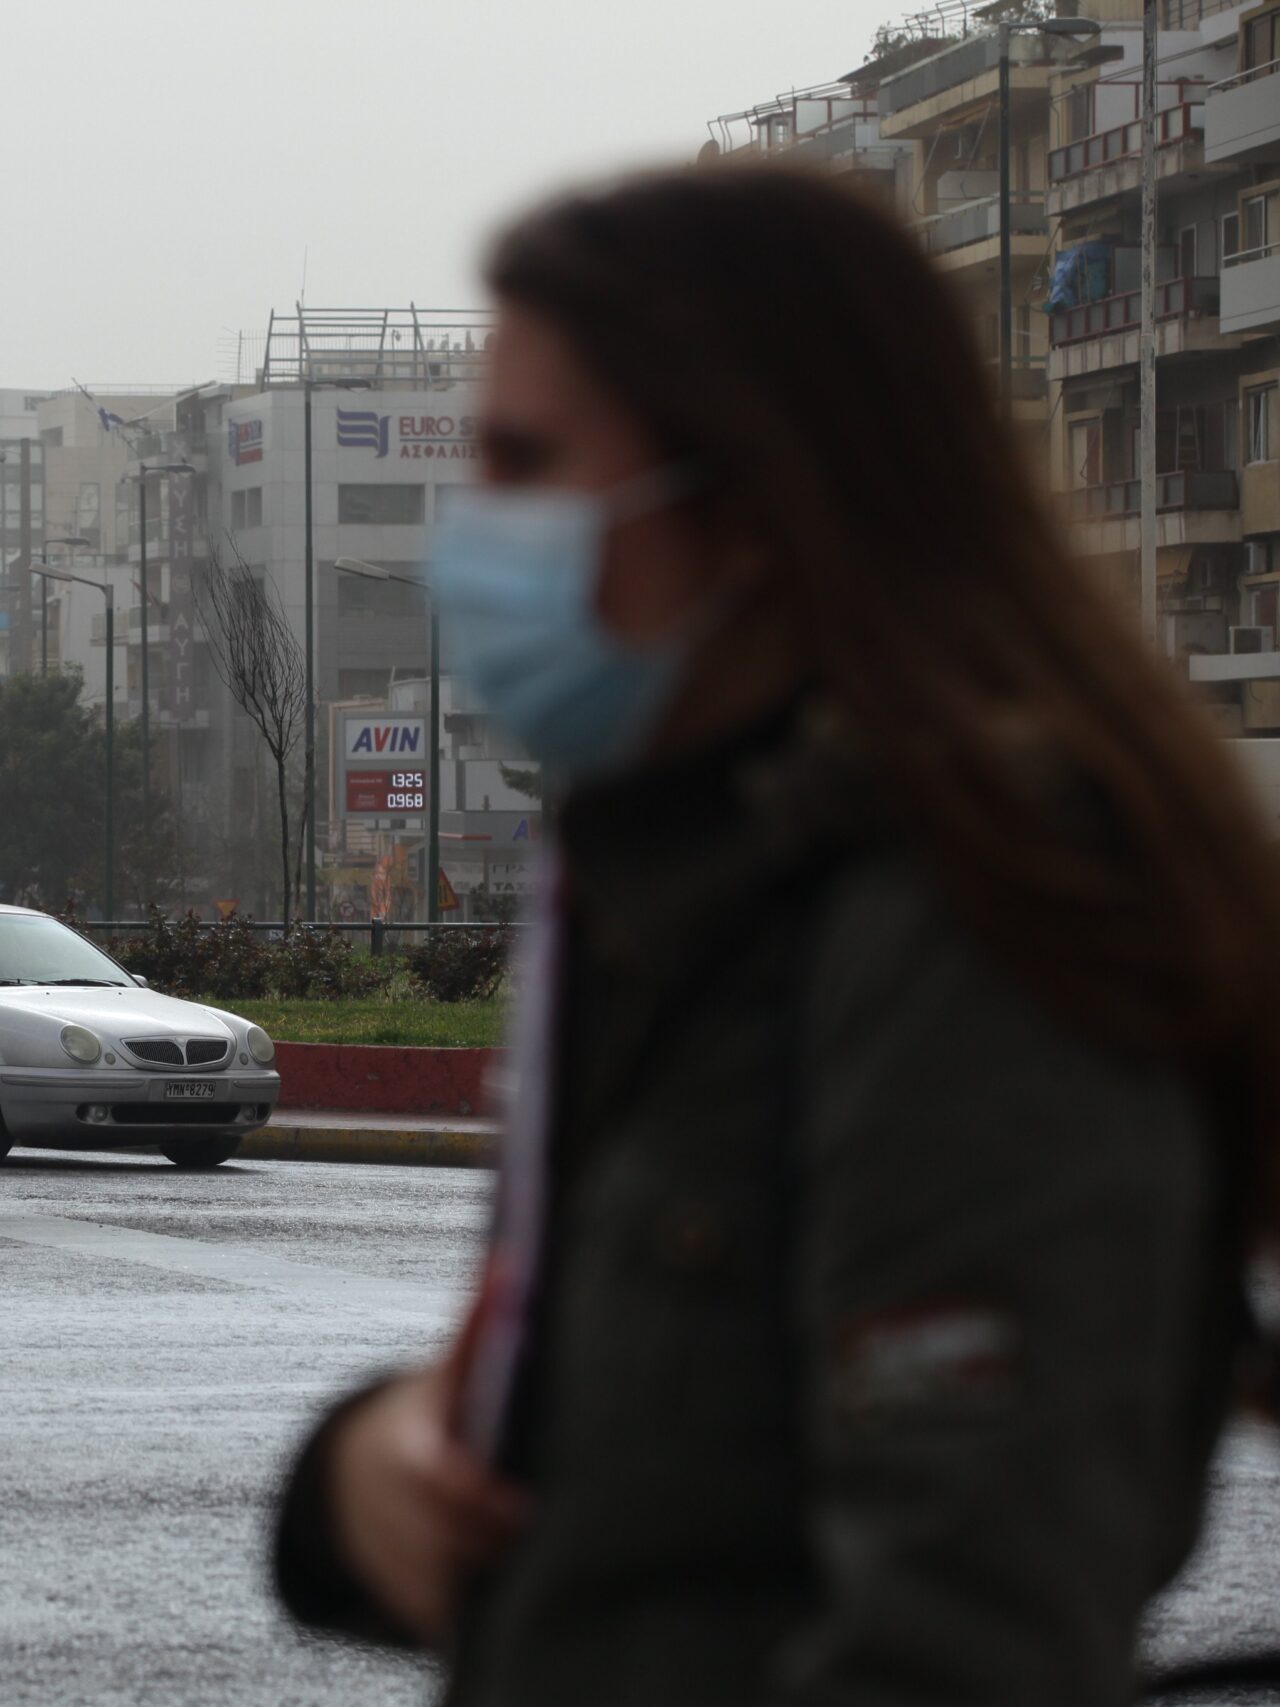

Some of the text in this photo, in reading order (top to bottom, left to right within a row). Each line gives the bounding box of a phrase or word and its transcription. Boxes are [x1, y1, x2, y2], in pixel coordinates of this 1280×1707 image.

[399, 416, 455, 436] EURO
[400, 445, 479, 459] ΑΣΦΑΛΙΣ
[174, 612, 191, 705] ΑΥΓΗ
[351, 727, 420, 752] AVIN
